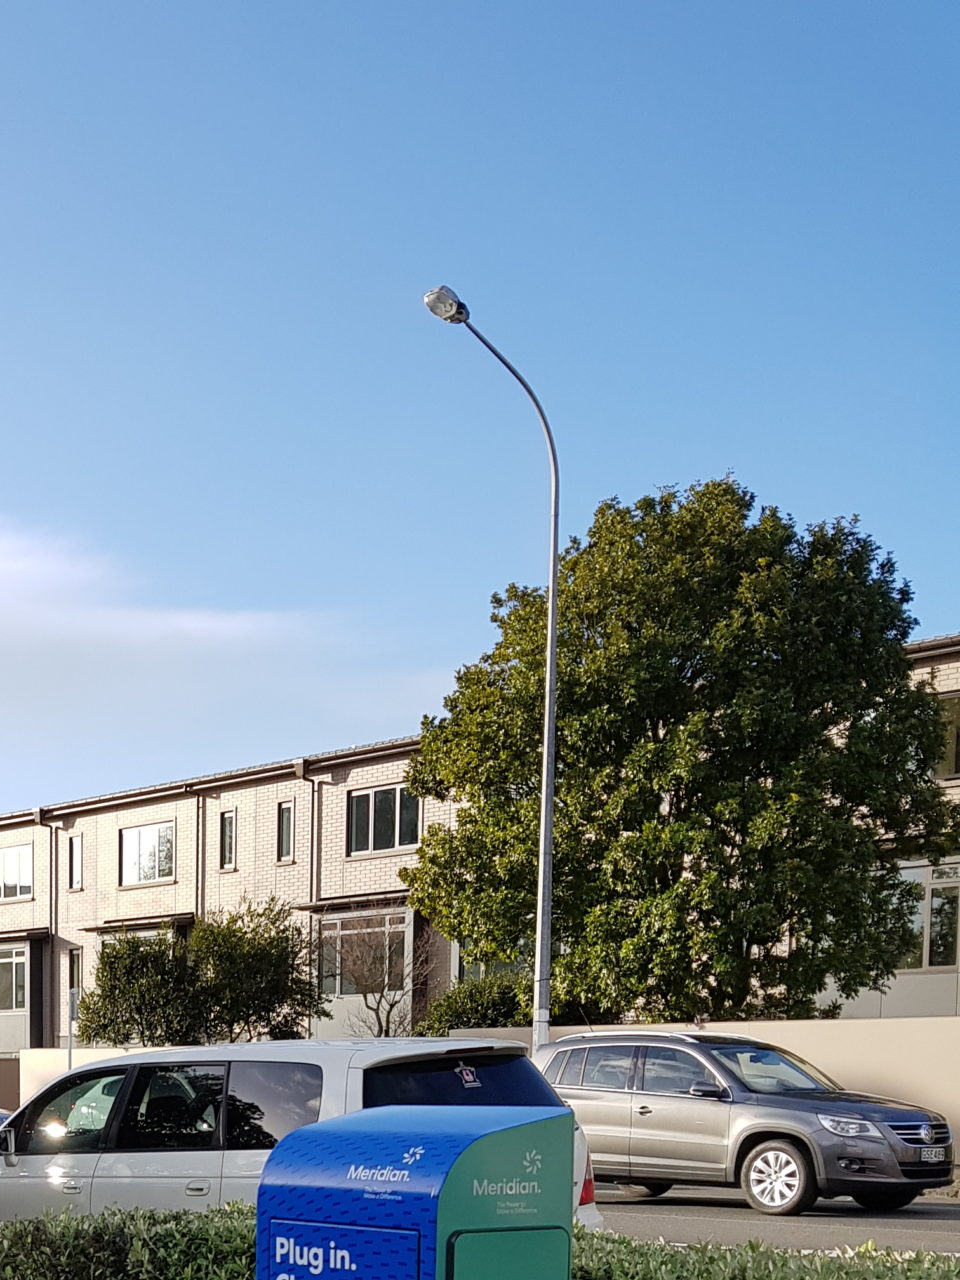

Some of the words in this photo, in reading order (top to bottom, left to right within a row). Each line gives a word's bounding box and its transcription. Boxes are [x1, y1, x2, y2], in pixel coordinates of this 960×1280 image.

[346, 1164, 410, 1182] Meridian.
[473, 1178, 541, 1196] Meridian.
[276, 1236, 324, 1274] Plug
[330, 1241, 357, 1270] in.
